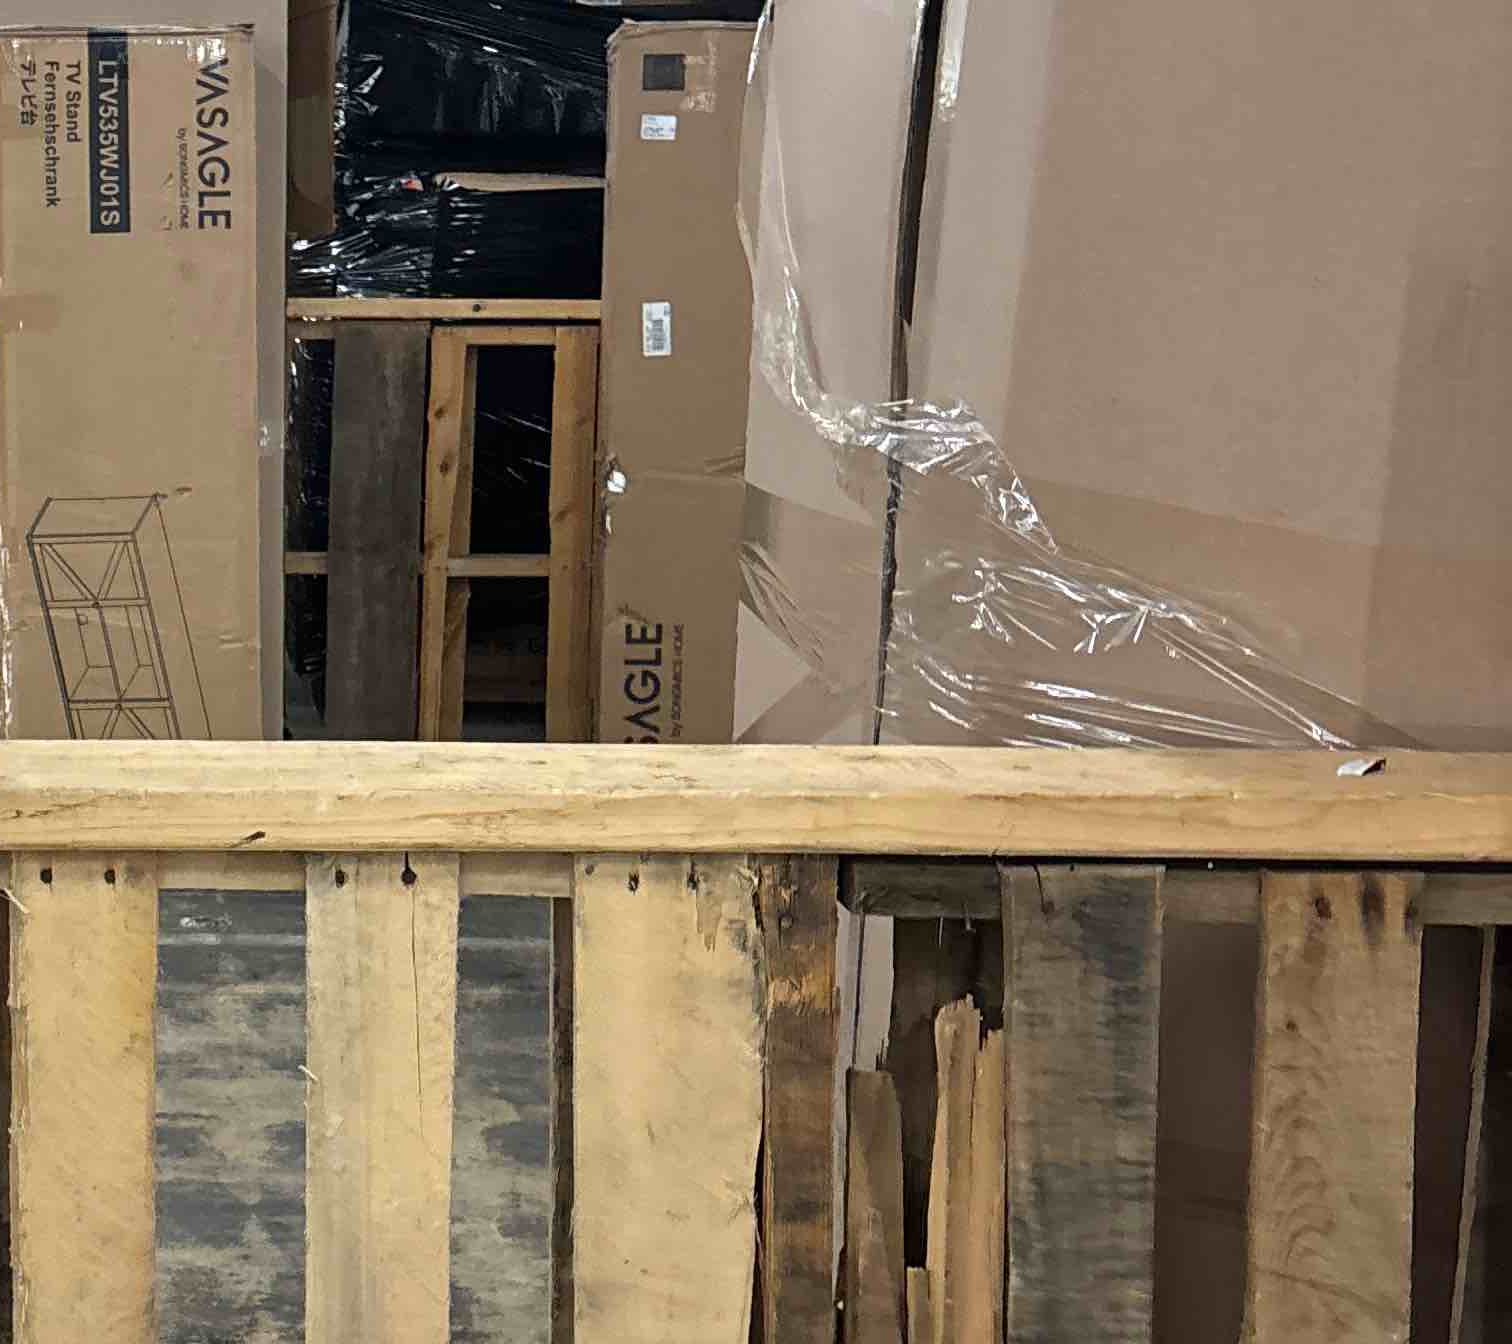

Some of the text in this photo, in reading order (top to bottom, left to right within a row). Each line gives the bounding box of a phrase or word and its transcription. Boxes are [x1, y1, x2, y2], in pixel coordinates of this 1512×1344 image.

[20, 60, 37, 126] テレビ台
[43, 60, 61, 208] Fernsehschrank
[65, 60, 82, 143] TV Stand
[97, 60, 120, 227] LTV535WJ01S
[196, 57, 232, 230] VASAGLE
